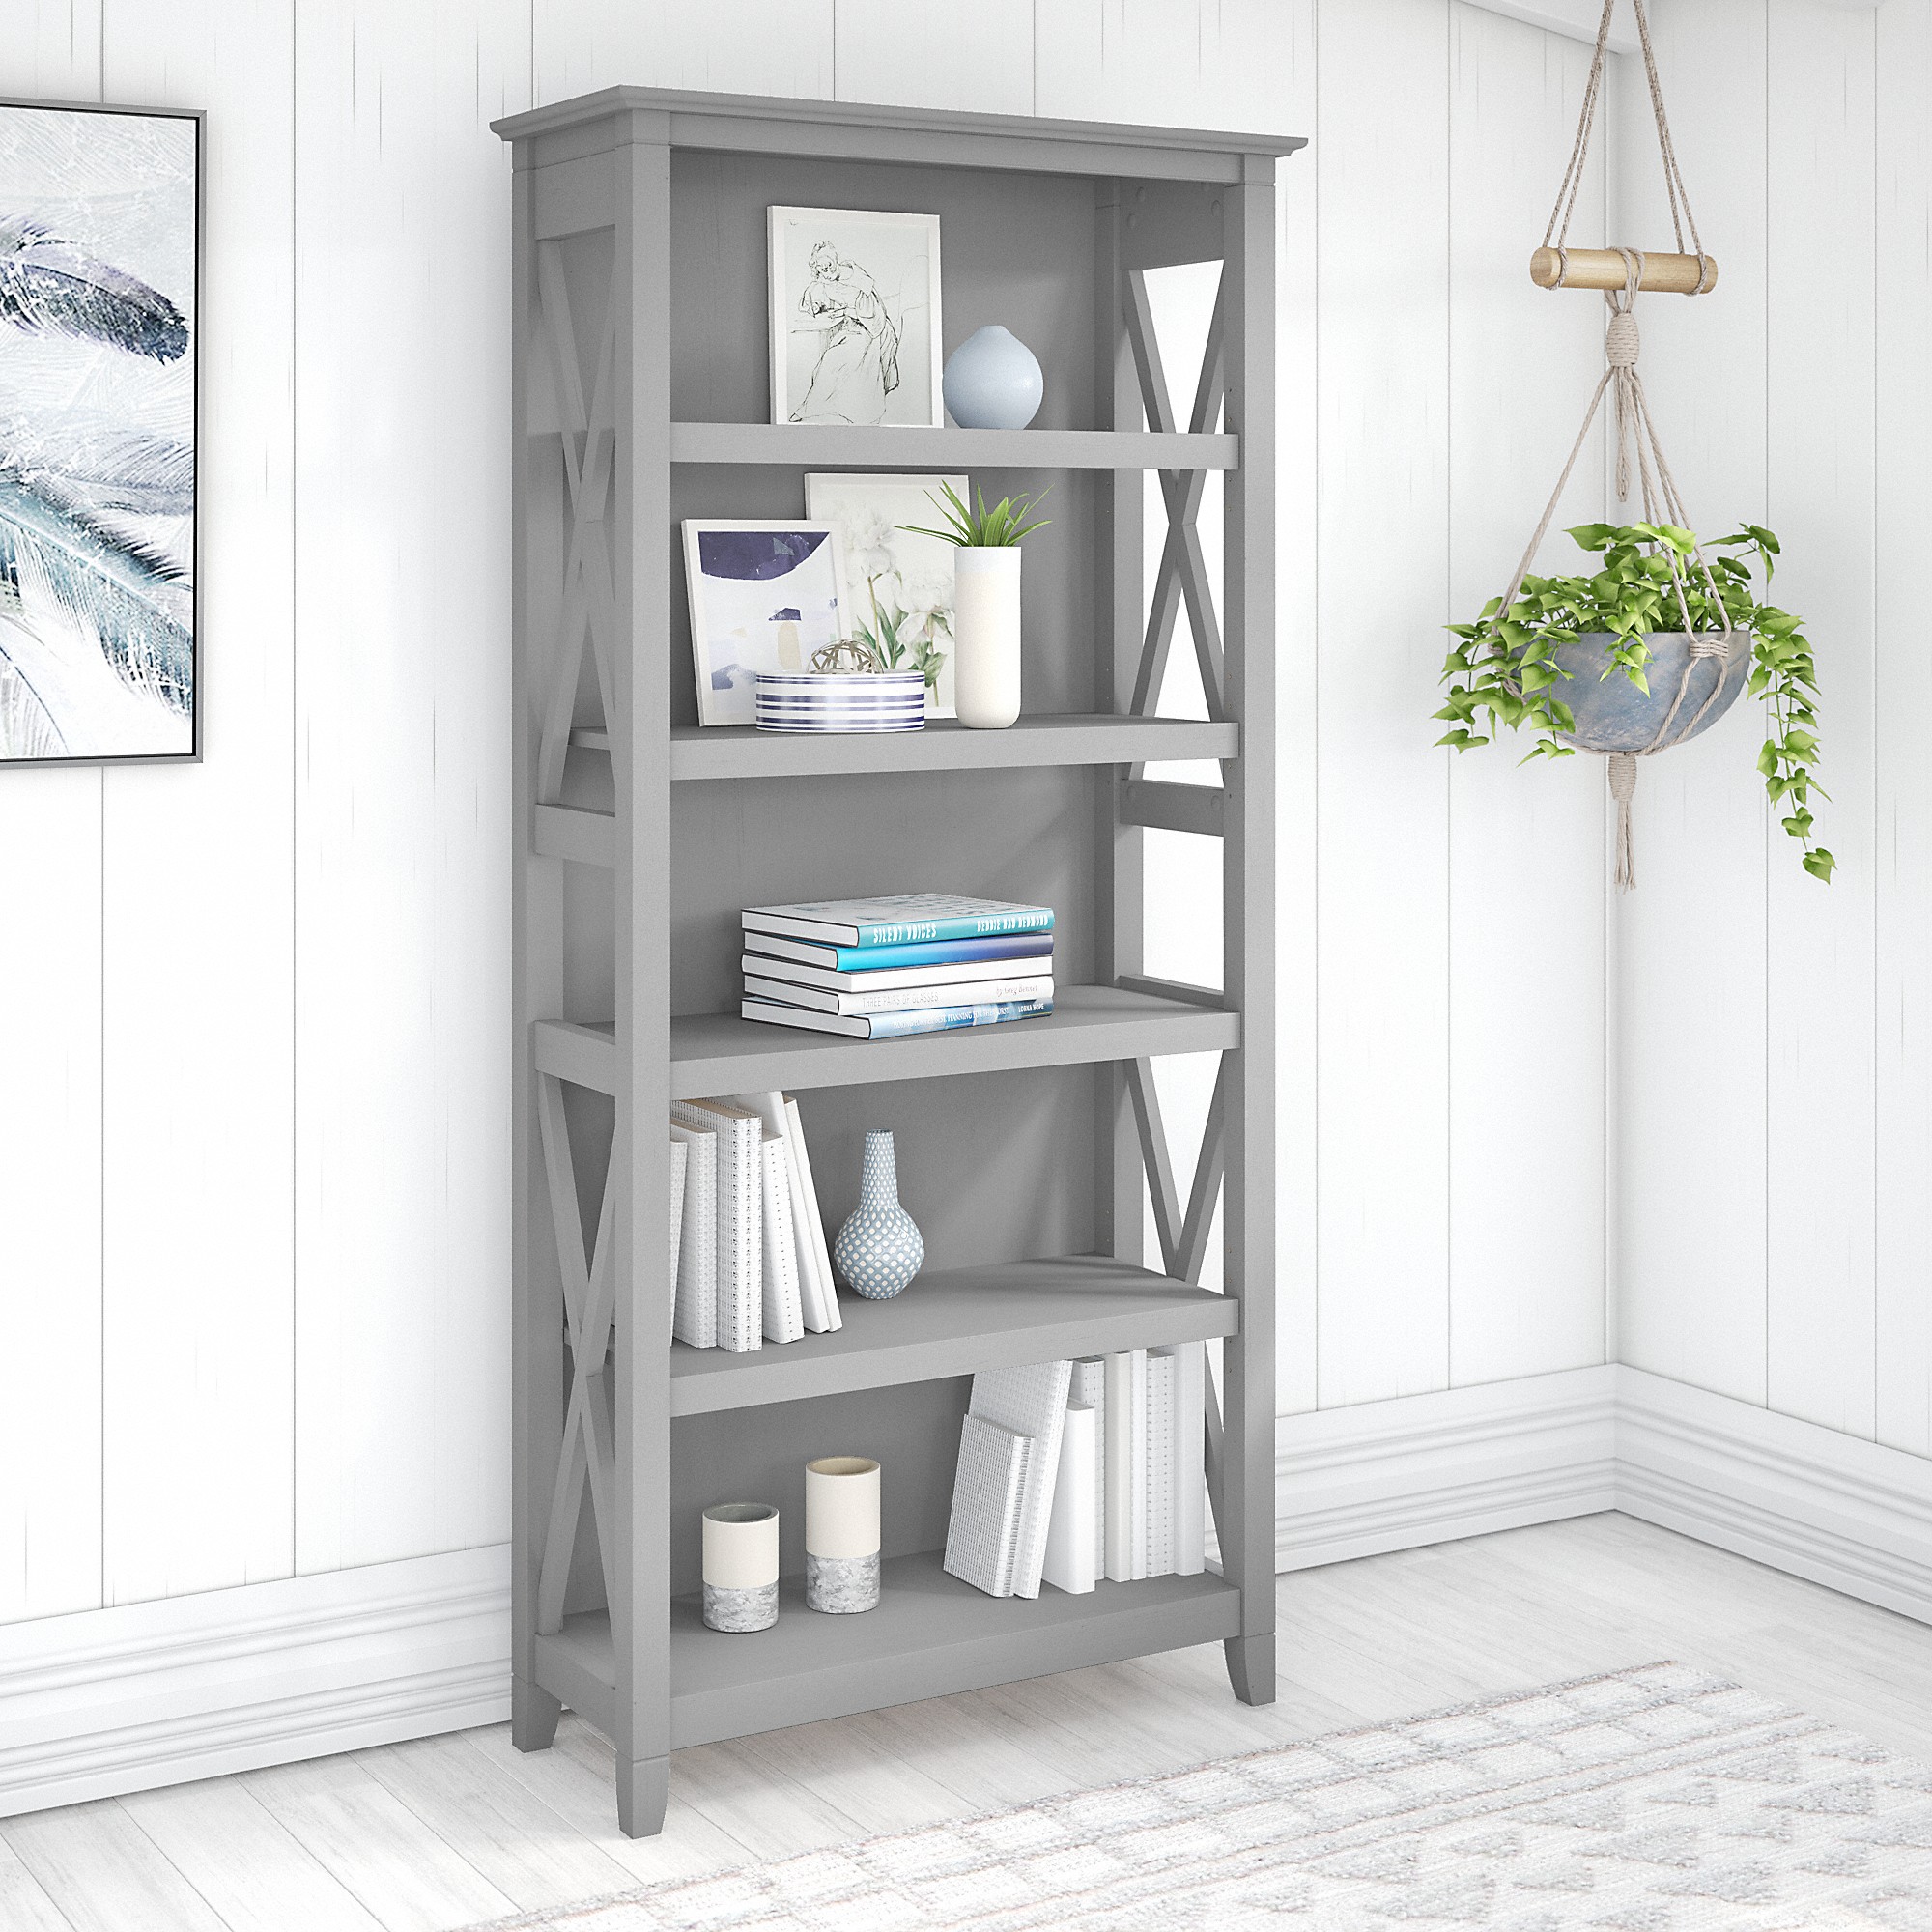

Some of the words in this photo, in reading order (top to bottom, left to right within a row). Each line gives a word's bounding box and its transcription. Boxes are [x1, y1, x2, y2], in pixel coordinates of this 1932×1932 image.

[873, 926, 903, 944] SILENT
[906, 923, 937, 941] VOICES
[862, 996, 881, 1008] THREE
